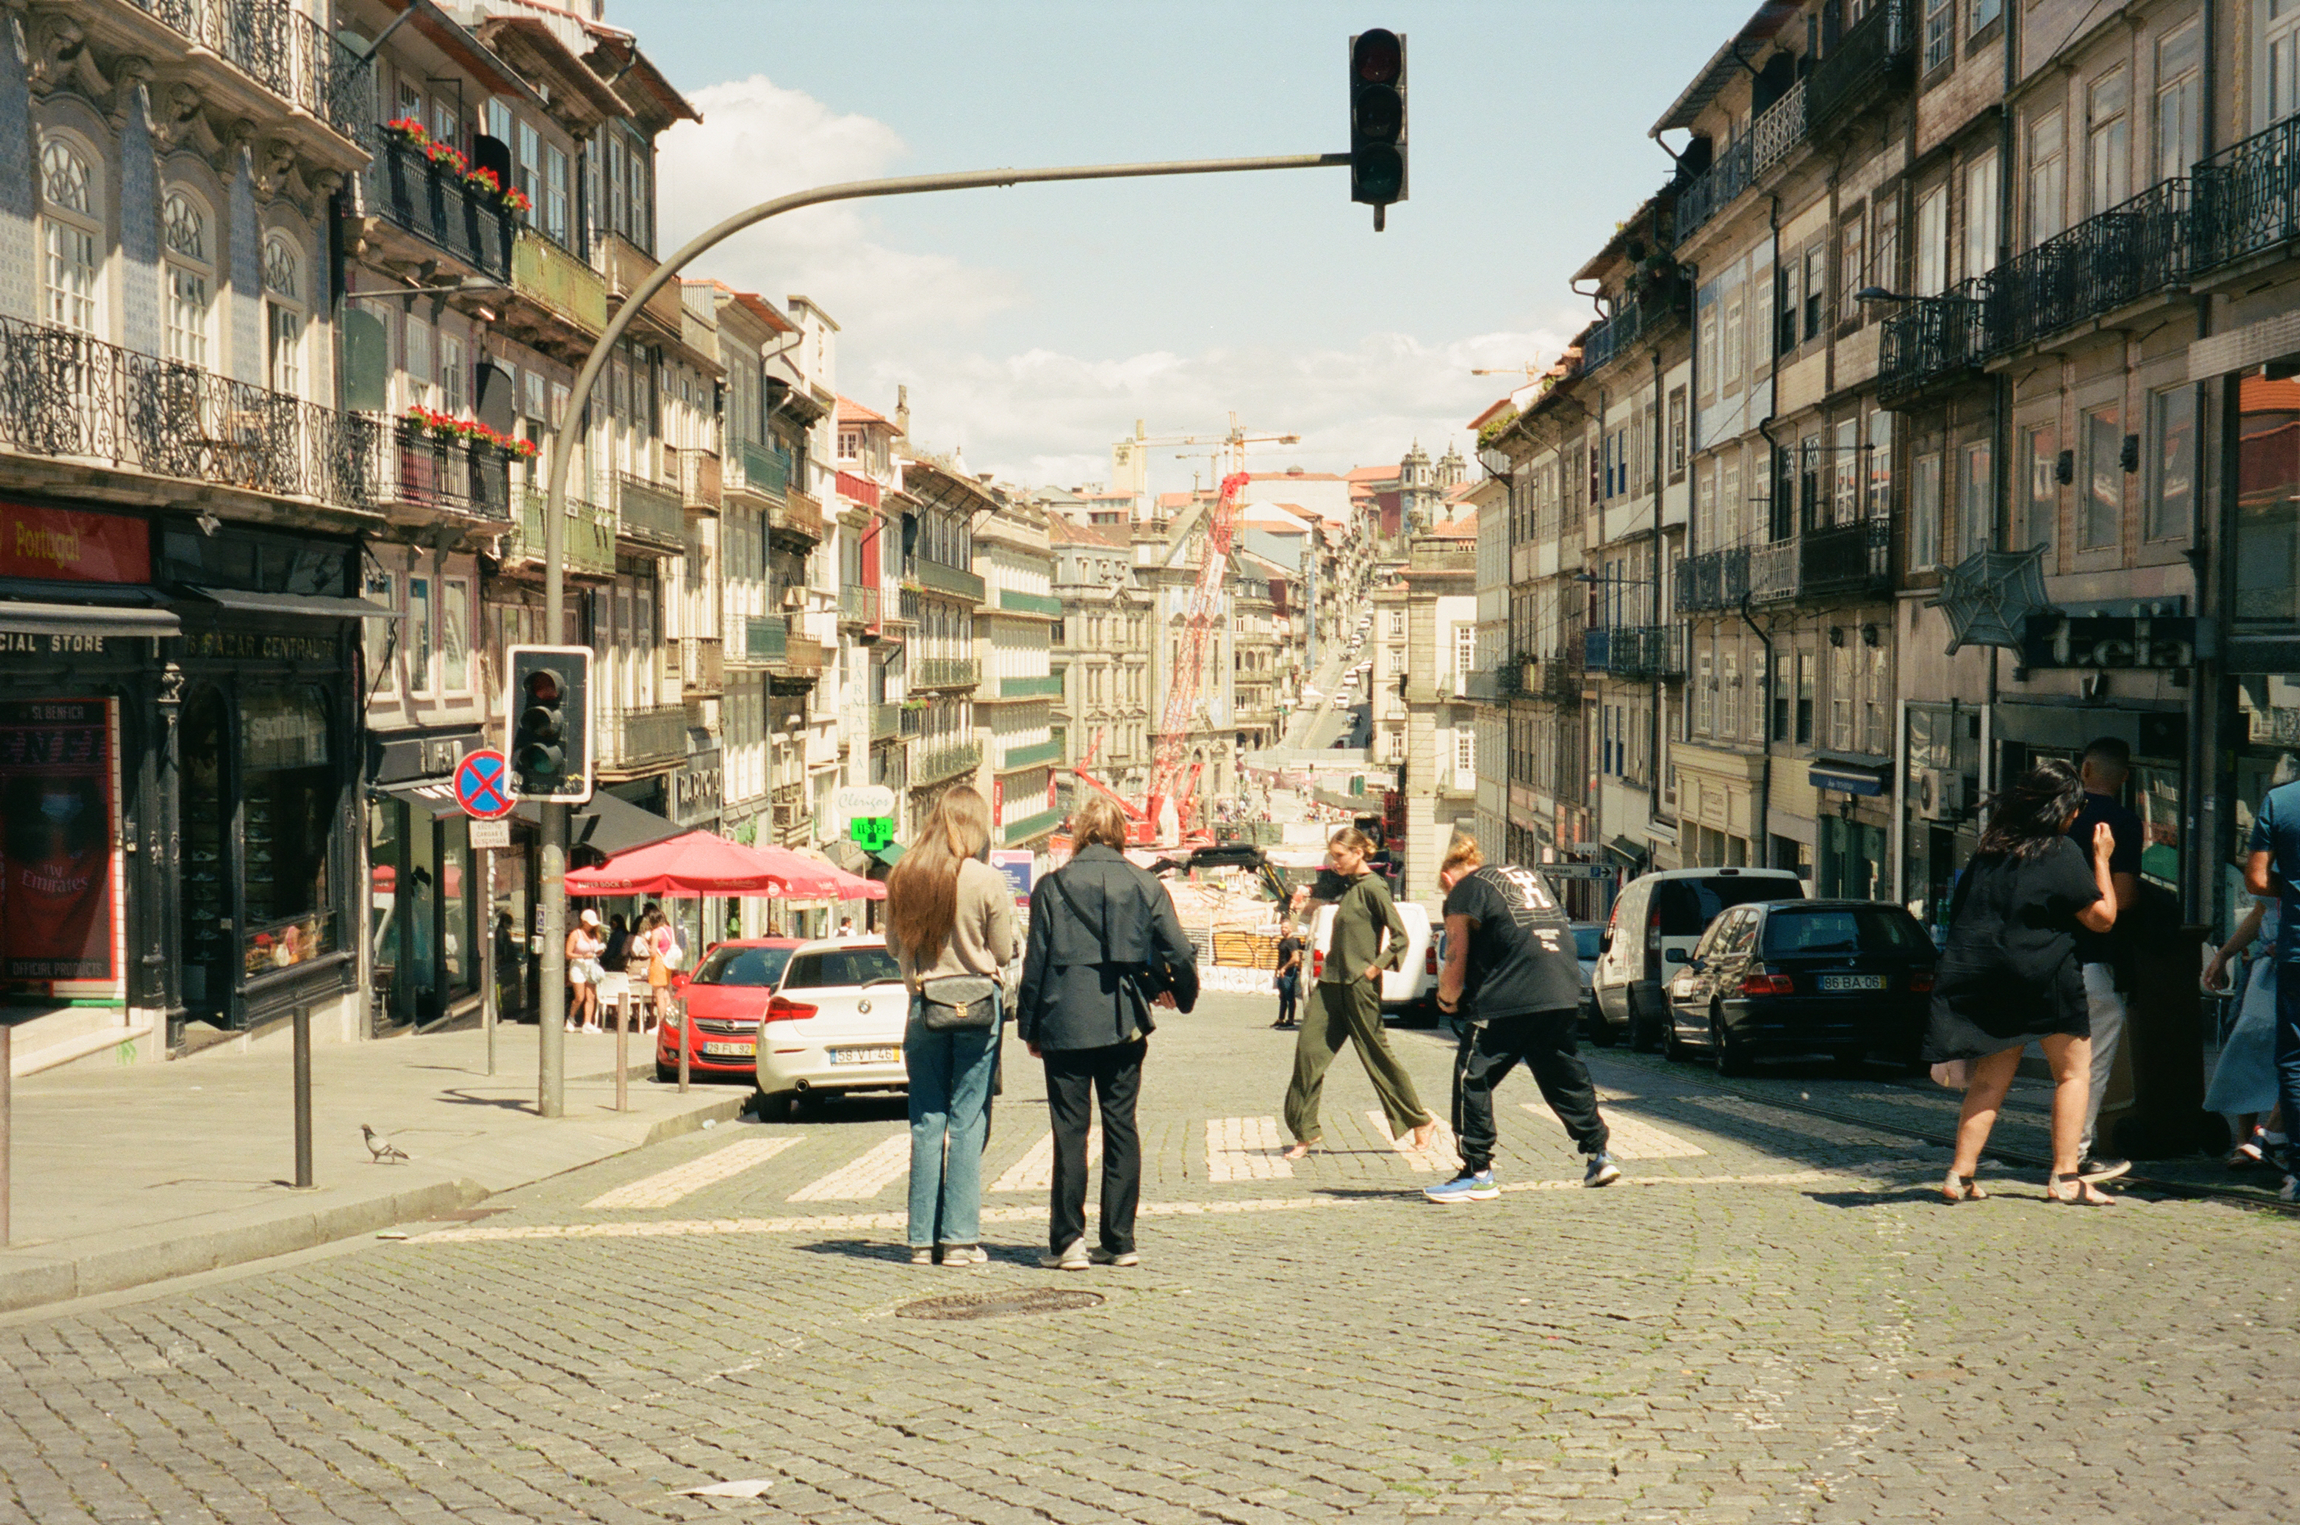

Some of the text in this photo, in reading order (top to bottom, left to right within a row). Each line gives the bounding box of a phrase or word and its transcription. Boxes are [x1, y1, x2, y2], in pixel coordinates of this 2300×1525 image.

[15, 520, 81, 569] Portugal
[51, 634, 103, 652] STORE
[263, 636, 320, 660] CENTRAL
[45, 705, 84, 720] BENFICA
[852, 656, 866, 769] FARMACIA
[22, 869, 89, 893] Emirates
[577, 881, 620, 889] SUPER BOCK
[13, 962, 102, 977] OFFICIAL PRODUCTS
